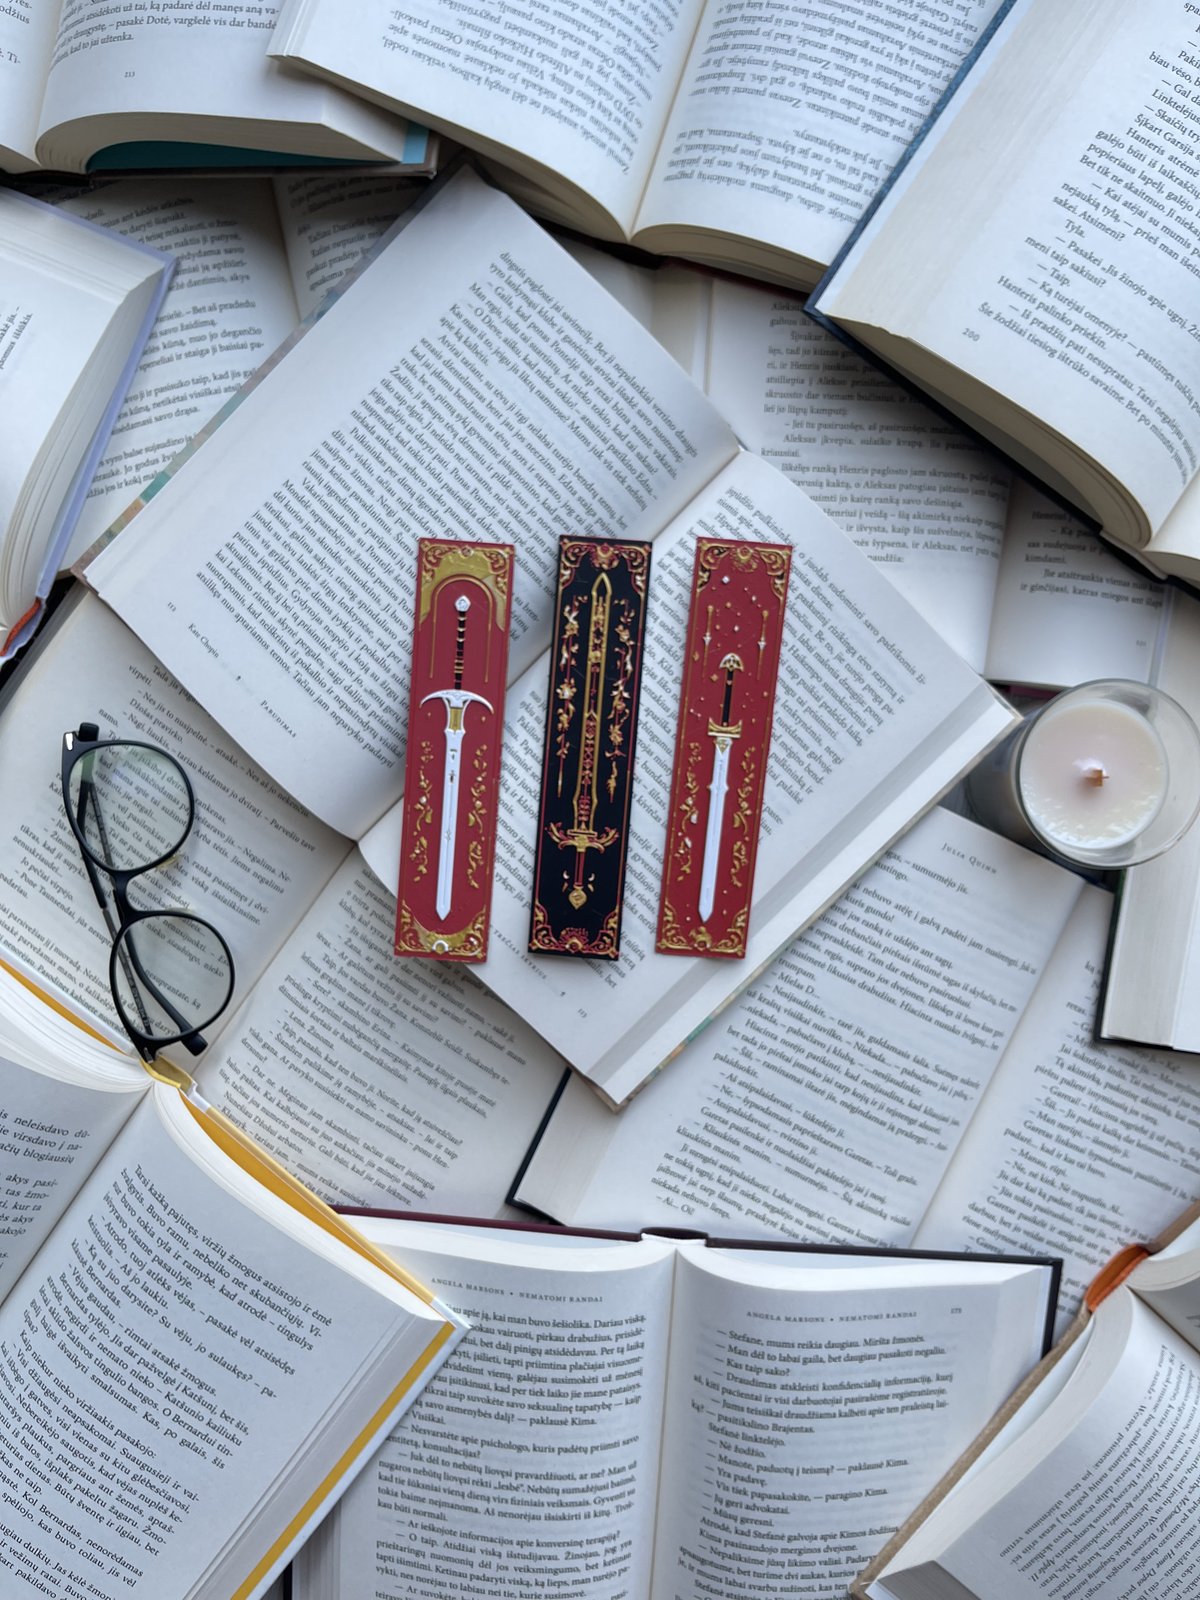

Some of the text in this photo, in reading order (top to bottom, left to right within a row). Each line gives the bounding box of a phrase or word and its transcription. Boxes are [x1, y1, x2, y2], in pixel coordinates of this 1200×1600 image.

[115, 15, 145, 31] pasakė
[145, 14, 172, 26] Dotė,
[173, 15, 212, 28] vargšelė
[213, 16, 228, 26] vis
[228, 16, 246, 28] dar
[134, 1, 149, 14] tai,
[149, 0, 161, 12] ką
[161, 0, 194, 13] padarė
[195, 0, 212, 11] dėl
[211, 4, 244, 15] manęs
[244, 6, 263, 17] aną
[264, 7, 282, 17] va-
[1148, 50, 1193, 84] biau vėso,
[1173, 83, 1193, 100] Gal
[1134, 113, 1195, 157] Šįkart Garsija
[1154, 108, 1188, 136] Skaičių
[1125, 126, 1200, 178] Hanteris atrėmė
[1052, 196, 1126, 242] sakei. Atsimeni?
[1061, 182, 1180, 261] nejaukią tylą, prieš man
[1024, 236, 1107, 288] meni taip sakiusi?
[1066, 240, 1167, 311] Pasakei žinojo apie
[997, 275, 1106, 350] Hanteris palinko priekin.
[439, 316, 489, 367] apie ką kalbėtis.
[802, 556, 917, 676] juolab sudominti savo padrikomis
[128, 665, 153, 687] virpėti.
[196, 571, 365, 744] atsilikęs nuo aptariamos temos. Tačiau jam nepavyko
[142, 691, 208, 746] Nes jis to nusipelnė,
[12, 1117, 91, 1139] neleisdavo dū-
[13, 1131, 83, 1152] virsdavo į na-
[22, 1147, 75, 1164] blogiausių
[5, 1173, 58, 1189] akys pasi-
[5, 1187, 50, 1200] tas žmo-
[11, 1201, 31, 1211] kur
[143, 1203, 166, 1228] Buvo
[166, 1226, 190, 1251] ramu,
[192, 1248, 231, 1279] nebeliko
[231, 1276, 249, 1291] net
[248, 1288, 304, 1329] skubančiųjų.
[309, 1323, 322, 1338] Vi-
[147, 1183, 170, 1212] kažką
[166, 1207, 199, 1239] pajutęs,
[201, 1235, 227, 1260] viržių
[226, 1253, 263, 1282] žmogus
[262, 1279, 303, 1308] atsistojo
[301, 1302, 313, 1314] ir
[311, 1309, 332, 1327] ėmė
[104, 1221, 296, 1376] Atrodo, tuoj atlėks vėjas, pasakė vėl atsisėdęs
[16, 1347, 200, 1502] Visi džiaugėsi neapsakomai. Suaugusieji ir vai-
[30, 1350, 54, 1378] niekur
[52, 1376, 75, 1400] nieko
[75, 1397, 115, 1431] viržiaakis
[113, 1428, 157, 1459] pasakojo:
[424, 1400, 598, 1427] savo asmenybės dalį? paklausė Kima.
[445, 1390, 613, 1415] taip suvokėte savo seksualinę tapatybę
